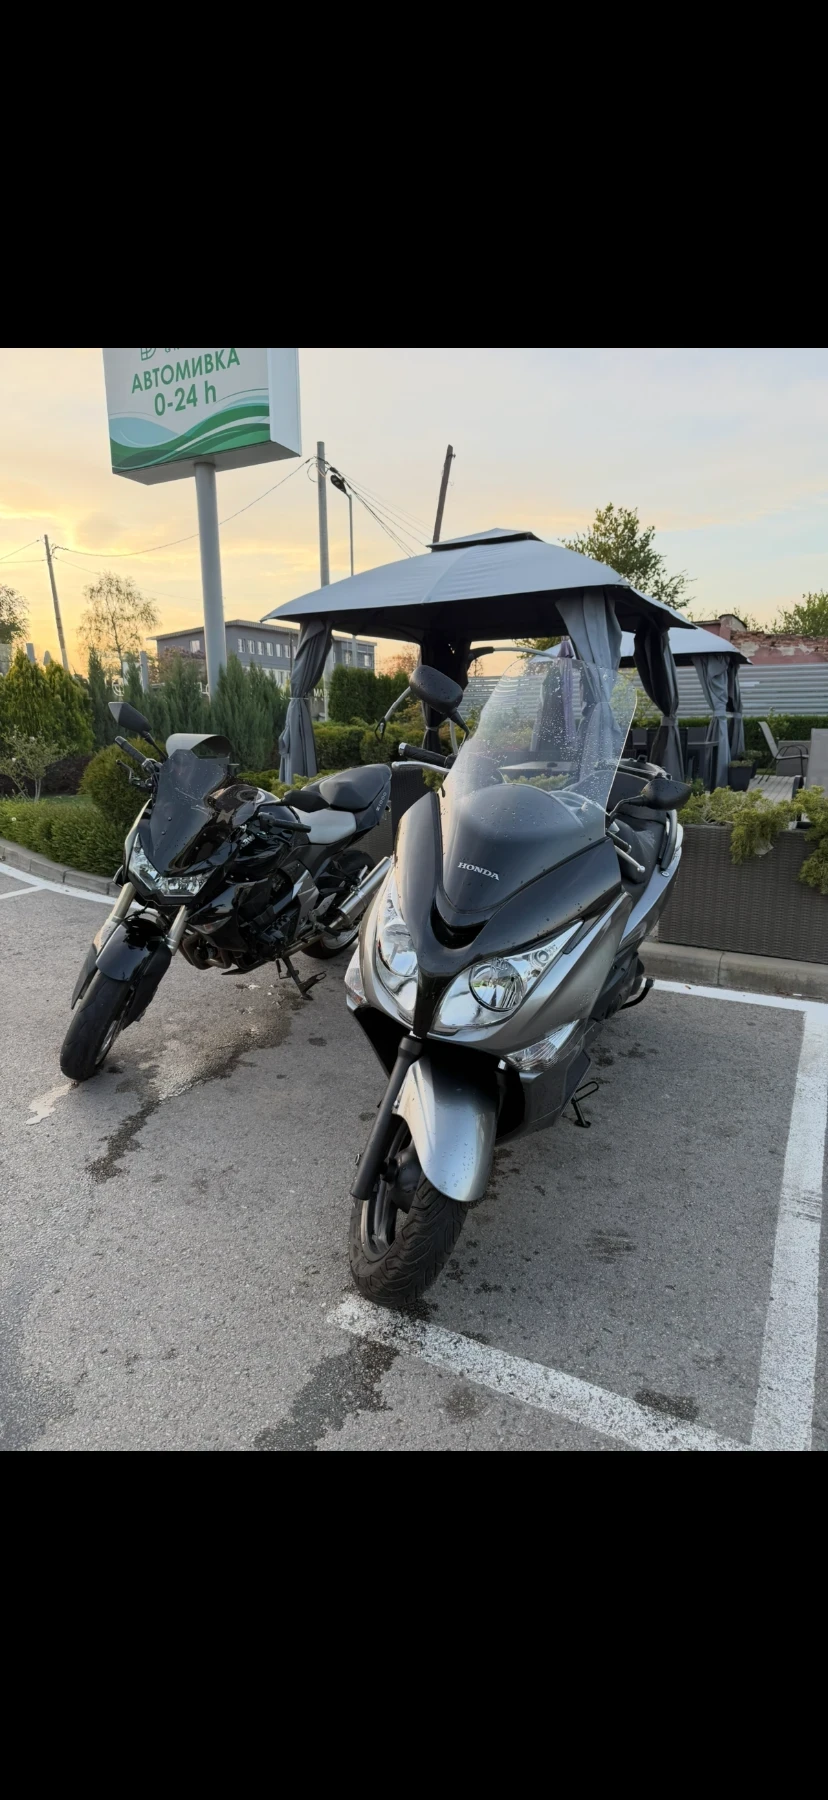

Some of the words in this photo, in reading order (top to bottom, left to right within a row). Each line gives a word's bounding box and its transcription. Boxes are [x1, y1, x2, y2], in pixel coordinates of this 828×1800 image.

[131, 348, 240, 394] АВТОМИВКА
[154, 384, 198, 416] 0-24
[205, 380, 217, 404] h
[457, 862, 500, 881] HONDA
